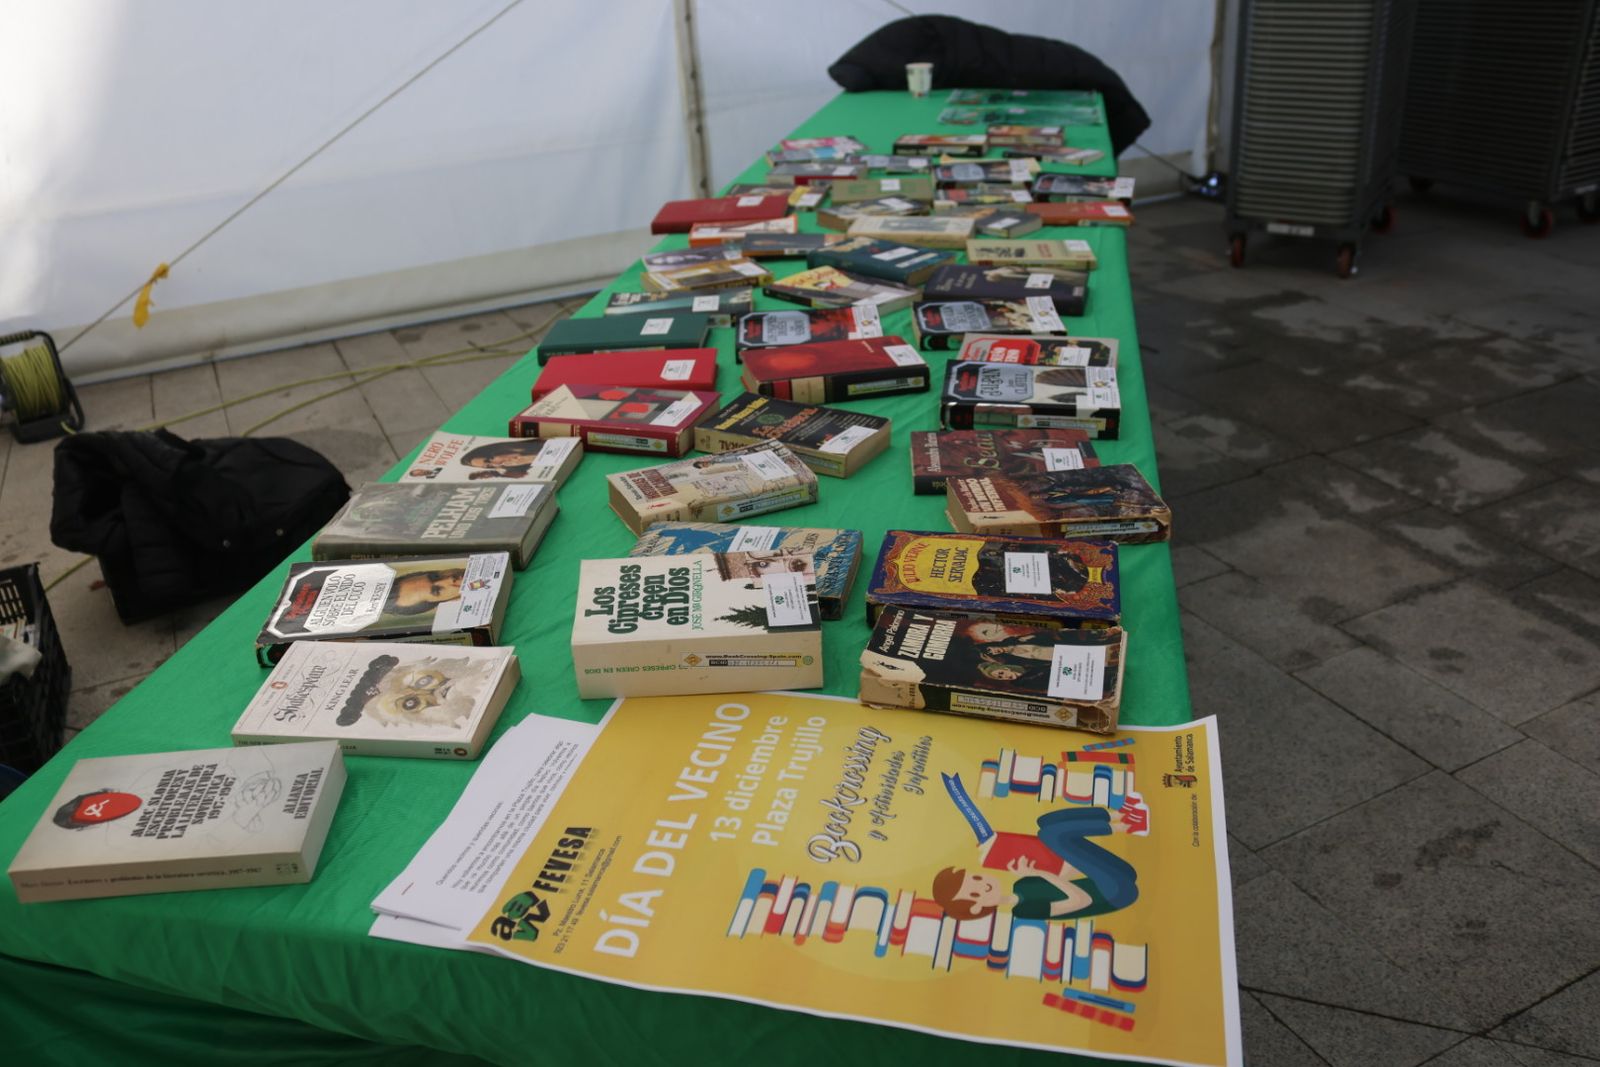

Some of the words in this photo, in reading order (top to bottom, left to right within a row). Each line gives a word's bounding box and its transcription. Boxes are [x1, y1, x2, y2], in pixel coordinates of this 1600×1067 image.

[420, 487, 482, 539] PELHAM
[449, 522, 472, 539] UNO
[665, 566, 690, 603] Dios
[929, 548, 952, 580] HECTOR
[309, 593, 332, 626] ALGUIEN
[322, 603, 341, 627] SOBRE
[338, 573, 357, 593] NIDO
[340, 600, 355, 616] DEL
[345, 581, 366, 604] CUCO
[584, 586, 616, 617] Los
[607, 564, 642, 634] Cipreses
[666, 602, 690, 626] en
[887, 609, 905, 632] Palomino
[897, 622, 929, 659] ZAMORA
[922, 619, 958, 661] GOMORRA
[273, 664, 328, 723] Shakespeare
[325, 687, 347, 711] KING
[341, 668, 360, 690] LEAR
[724, 715, 788, 811] diciembre
[903, 735, 933, 796] Infantiles
[1174, 735, 1183, 773] Ayuntamiento
[1185, 734, 1194, 764] Salamanca
[130, 808, 156, 837] MARC
[147, 769, 178, 807] SLONIM
[156, 777, 198, 840] PROBLEMAS
[188, 764, 205, 778] DE
[170, 825, 188, 839] LA
[180, 763, 218, 826] LITERATURA
[191, 774, 226, 825] SOVIETICA
[207, 776, 237, 820] 1917-1967
[282, 772, 309, 815] ALIANZA
[294, 767, 325, 820] EDITORIAL
[752, 787, 799, 847] Plaza
[777, 716, 827, 781] Trujillo
[144, 775, 187, 837] ESCRITORES
[593, 889, 664, 959] DÍA
[633, 813, 698, 878] DEL
[667, 703, 751, 801] VECINO
[709, 816, 743, 841] 13
[867, 829, 889, 841] y
[532, 827, 593, 893] FEVESA
